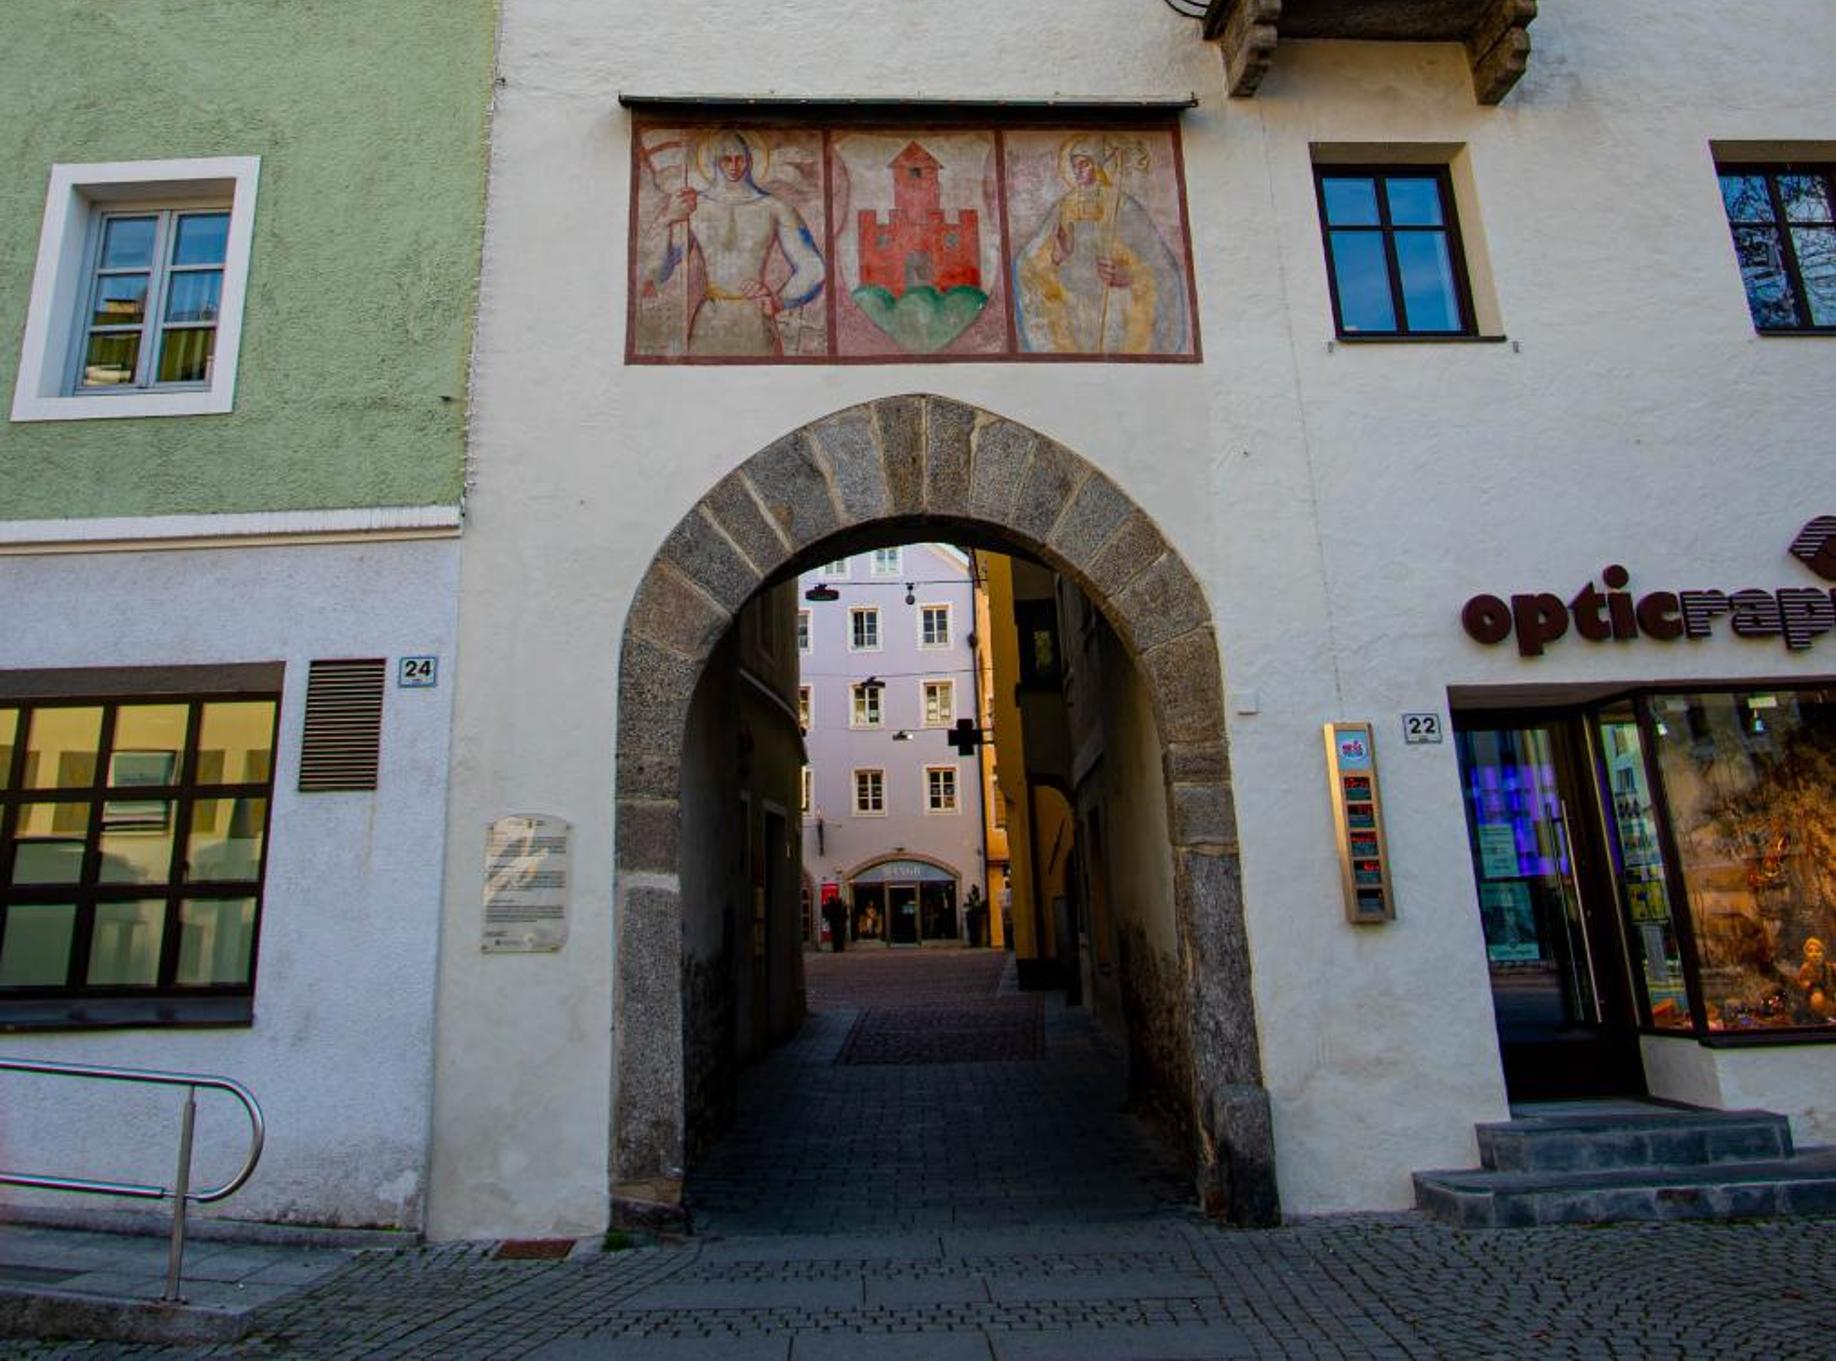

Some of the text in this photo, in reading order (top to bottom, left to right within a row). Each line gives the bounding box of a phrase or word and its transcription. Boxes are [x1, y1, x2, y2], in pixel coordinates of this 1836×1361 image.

[1462, 564, 1836, 657] opticrap
[404, 660, 432, 677] 24
[1408, 716, 1437, 734] 22
